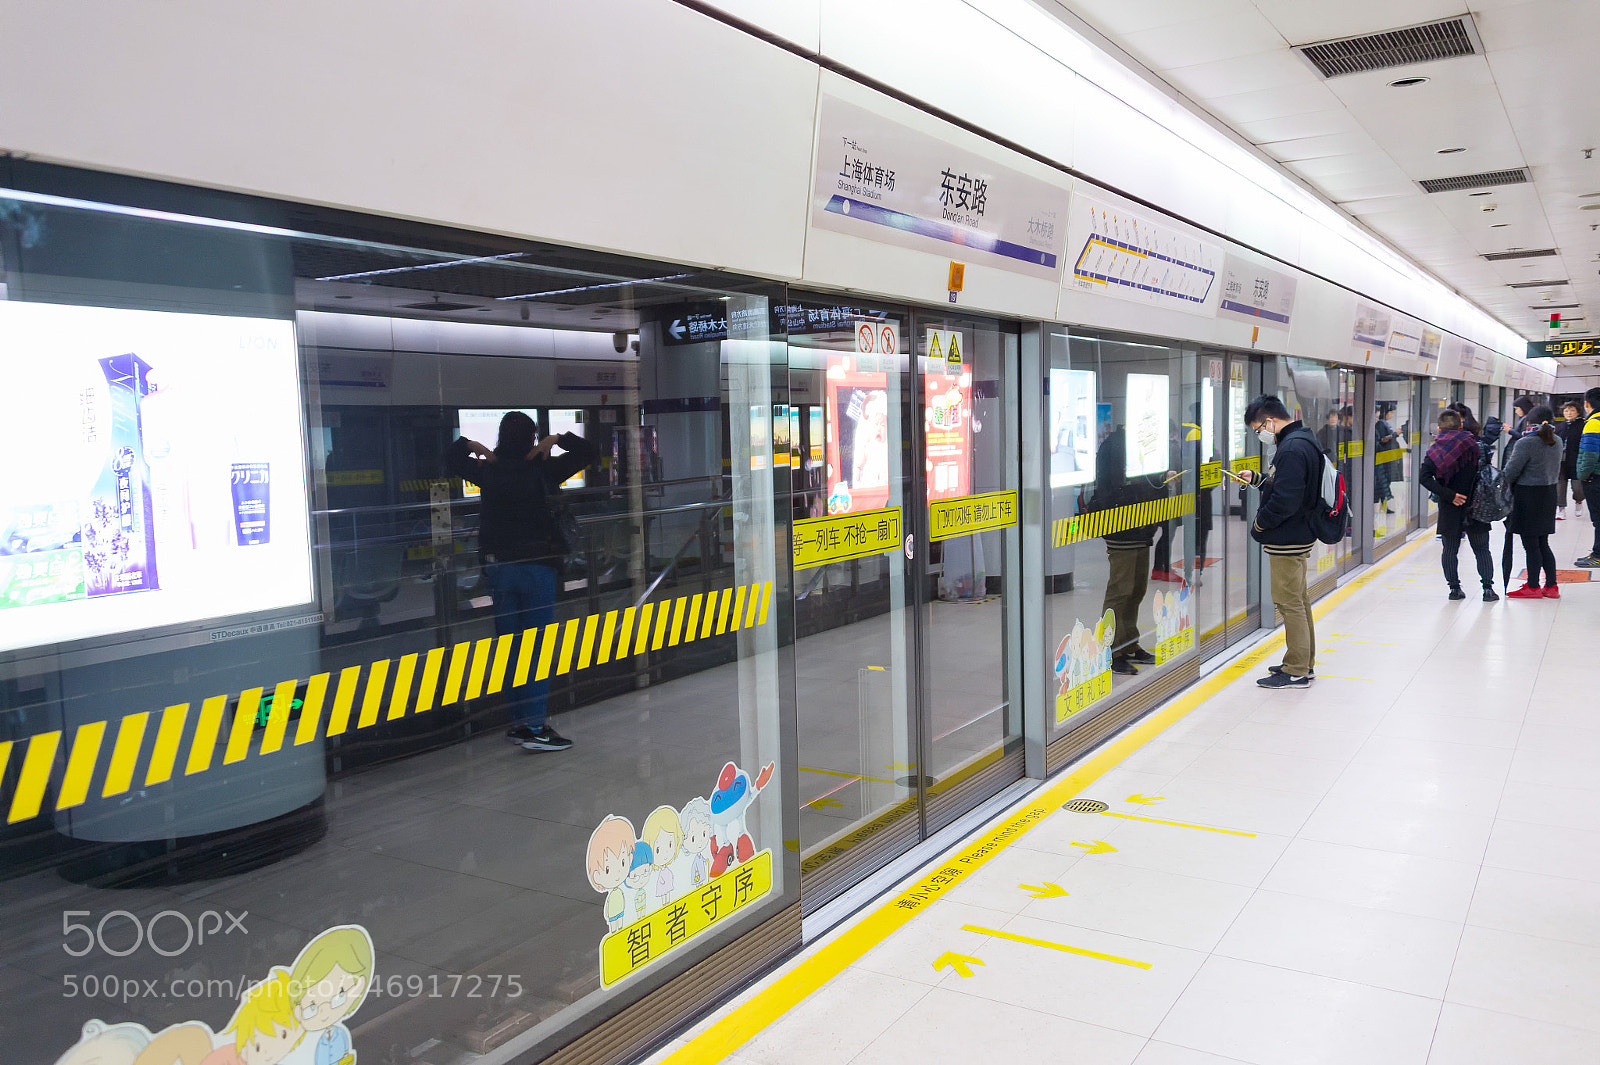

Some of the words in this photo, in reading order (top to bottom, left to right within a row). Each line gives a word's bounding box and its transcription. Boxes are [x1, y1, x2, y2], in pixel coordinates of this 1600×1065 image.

[839, 154, 896, 191] 上海体育场
[939, 167, 988, 217] 东安路
[965, 214, 979, 228] Road
[973, 499, 1012, 523] 请勿上下车
[843, 518, 898, 547] 不抢一扇门
[959, 842, 998, 864] Please
[993, 827, 1018, 842] mind
[1010, 818, 1030, 828] the
[627, 866, 754, 968] 智者守序
